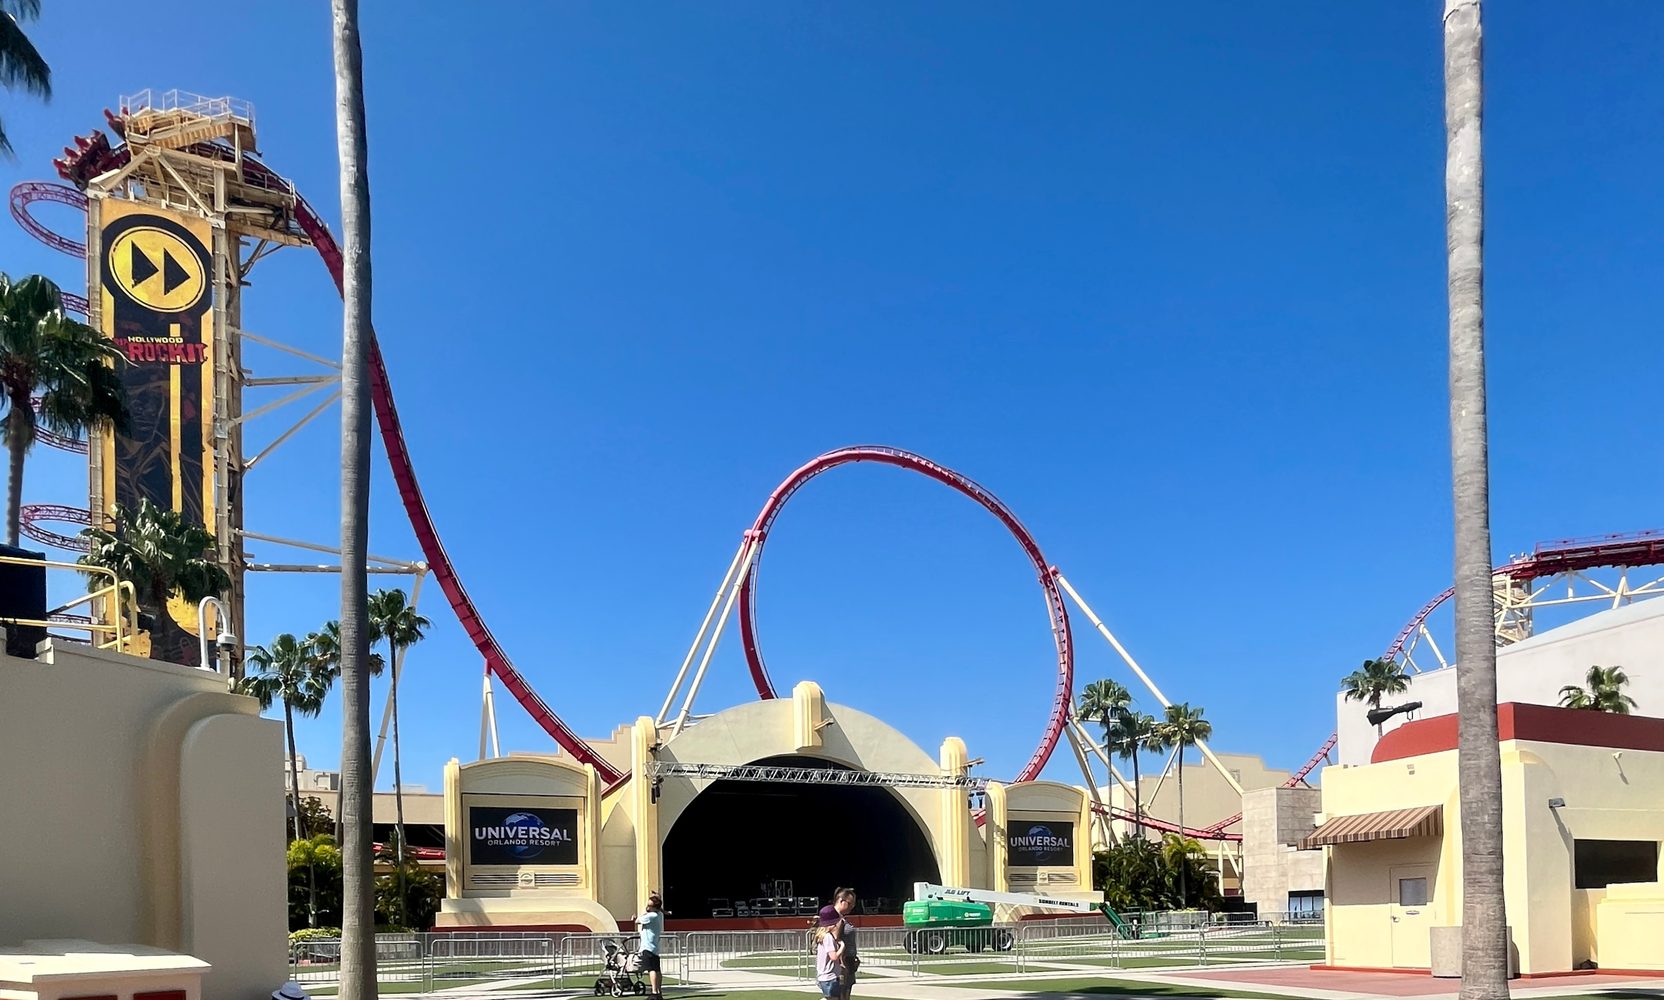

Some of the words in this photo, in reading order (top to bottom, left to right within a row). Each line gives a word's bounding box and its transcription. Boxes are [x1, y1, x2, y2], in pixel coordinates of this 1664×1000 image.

[128, 343, 204, 362] ROCKIT
[475, 826, 572, 841] UNIVERSAL
[1010, 836, 1070, 847] UNIVERSAL
